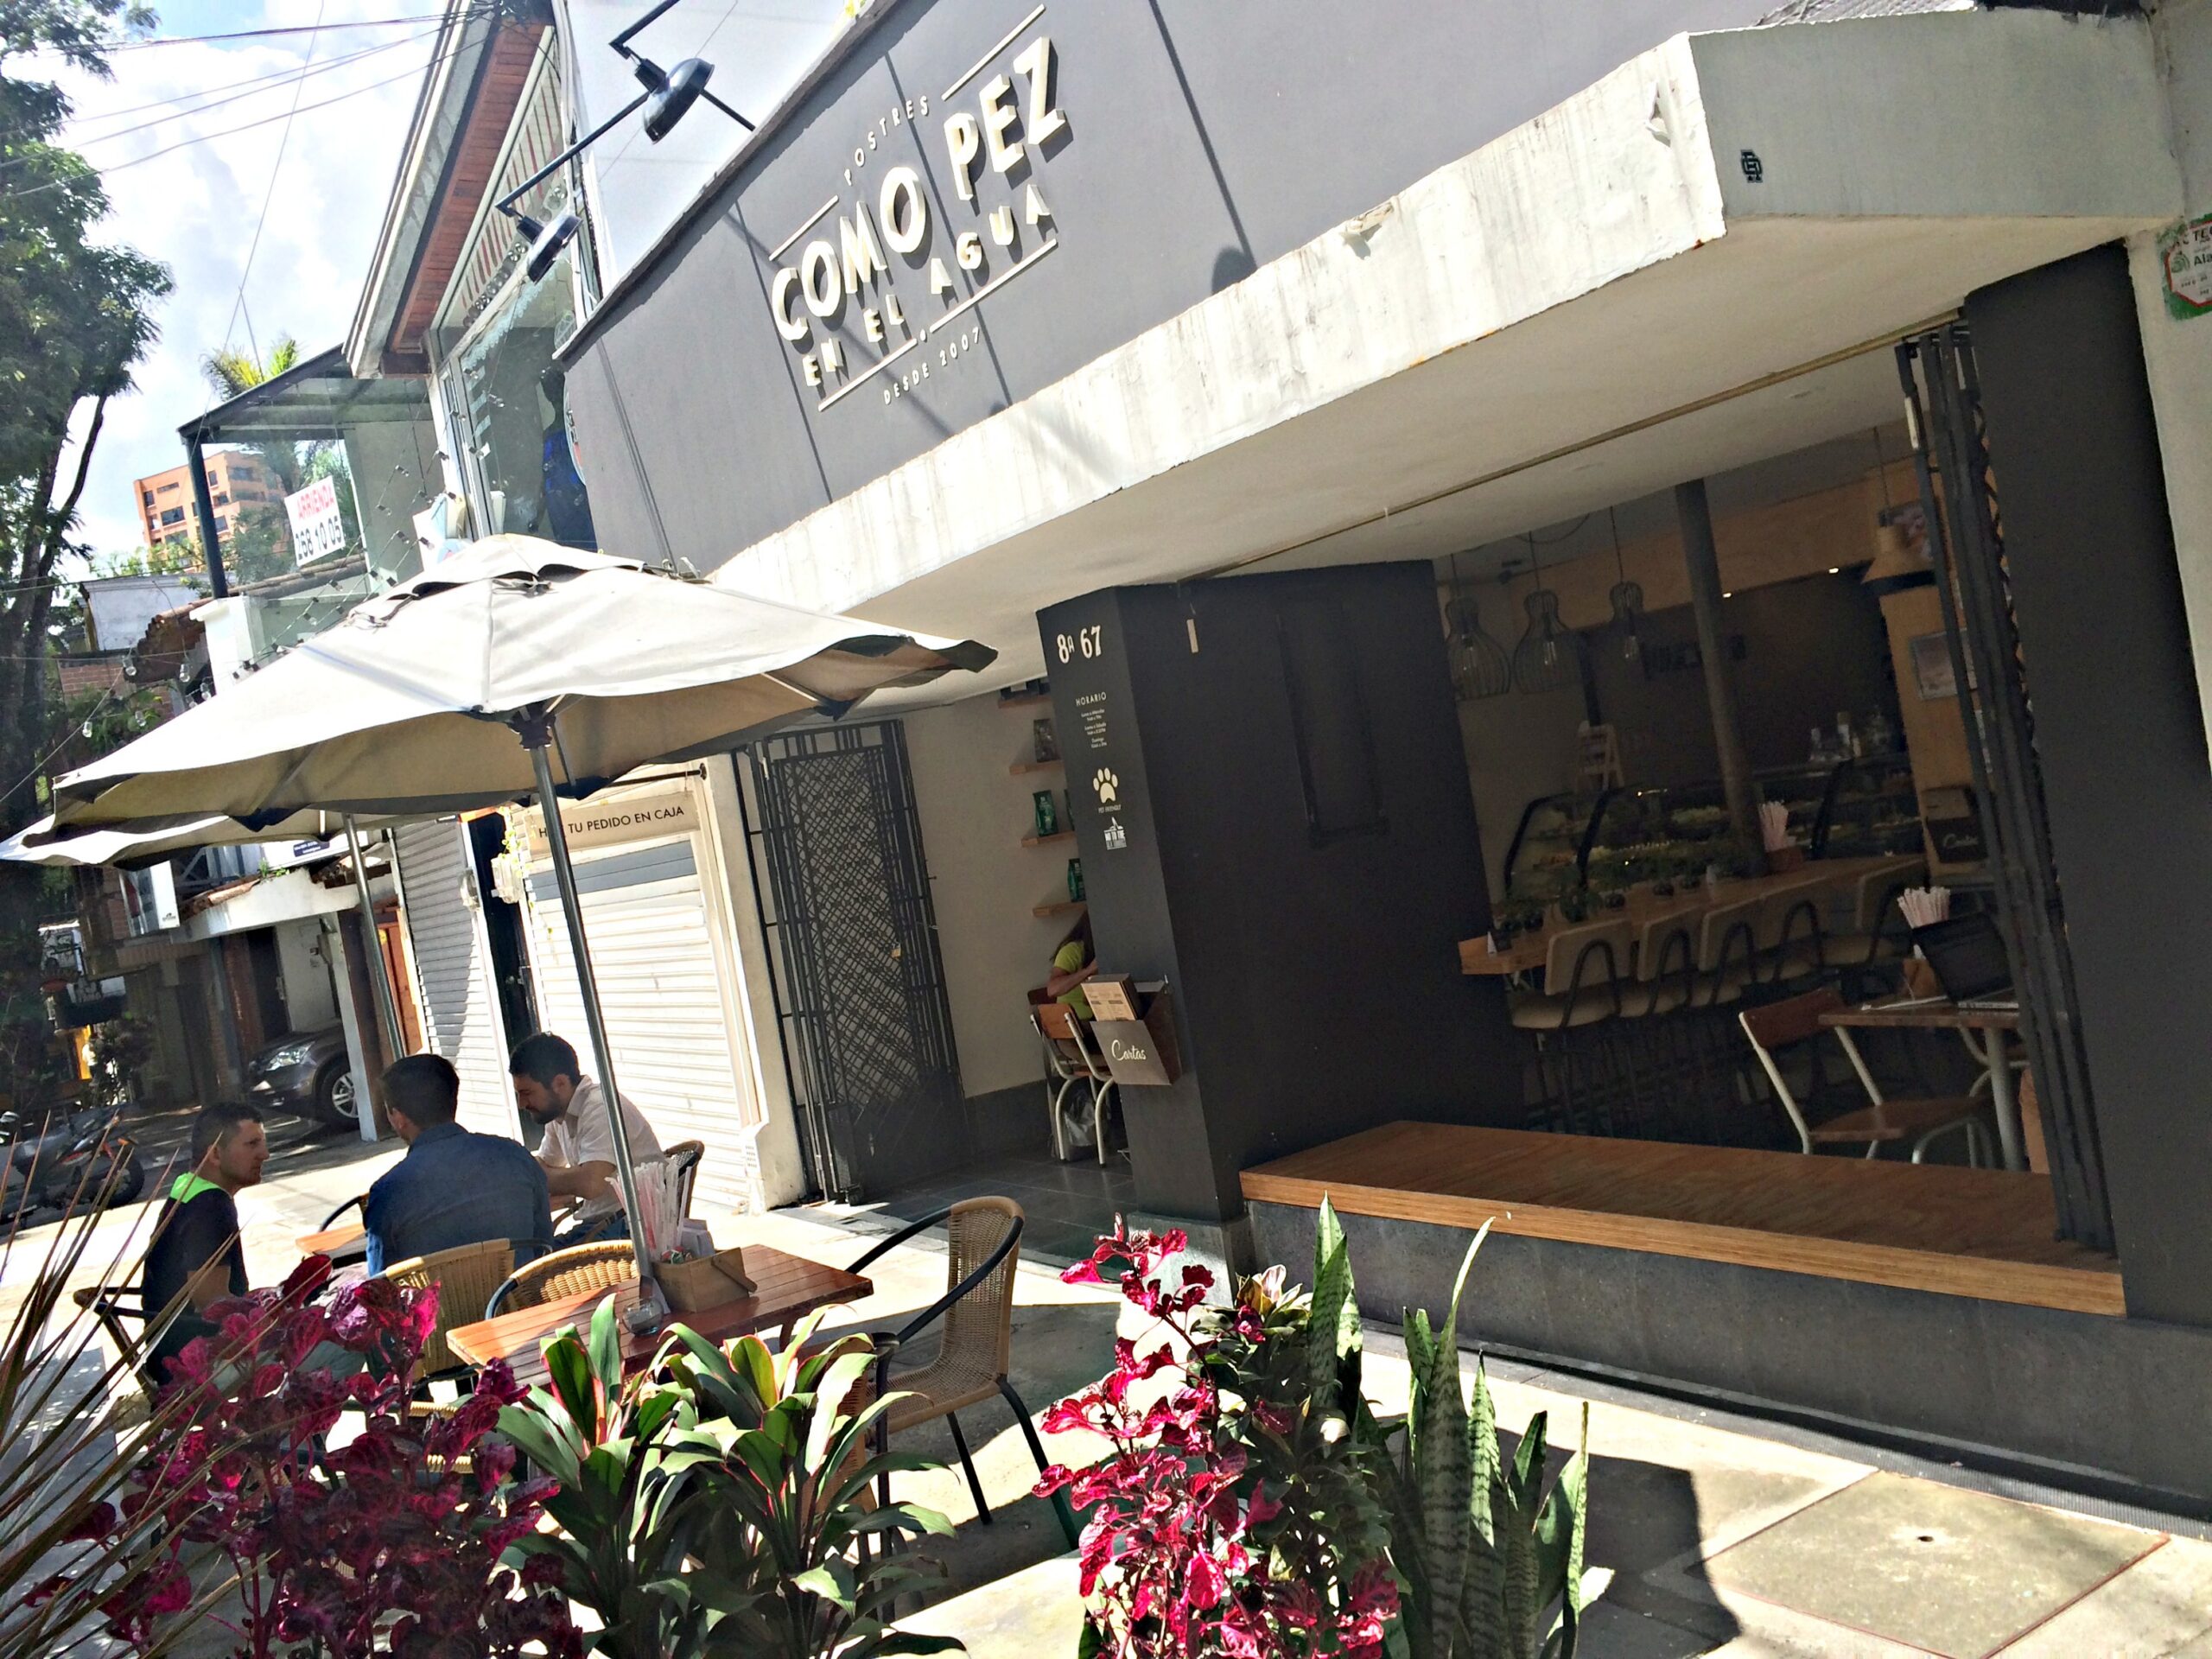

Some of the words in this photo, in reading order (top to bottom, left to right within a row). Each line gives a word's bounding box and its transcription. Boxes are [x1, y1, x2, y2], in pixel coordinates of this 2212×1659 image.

[844, 95, 928, 186] POSTRES
[772, 166, 926, 340] COMO
[944, 36, 1066, 200] PEZ
[803, 338, 844, 386] EN
[864, 294, 904, 342] EL
[931, 184, 1051, 295] AGUA
[883, 362, 929, 404] DESDE
[939, 327, 979, 366] 2007
[297, 485, 334, 519] ARRIENDA
[296, 528, 314, 560] 268
[315, 522, 327, 551] 10
[327, 516, 342, 546] 05
[1057, 633, 1075, 664] 8A
[1080, 625, 1102, 658] 67
[1075, 691, 1107, 707] HORARIO
[568, 823, 583, 835] TU
[588, 815, 631, 831] PEDIDO
[634, 811, 651, 823] EN
[654, 806, 684, 820] CAJA
[1111, 1039, 1147, 1061] Cartas
